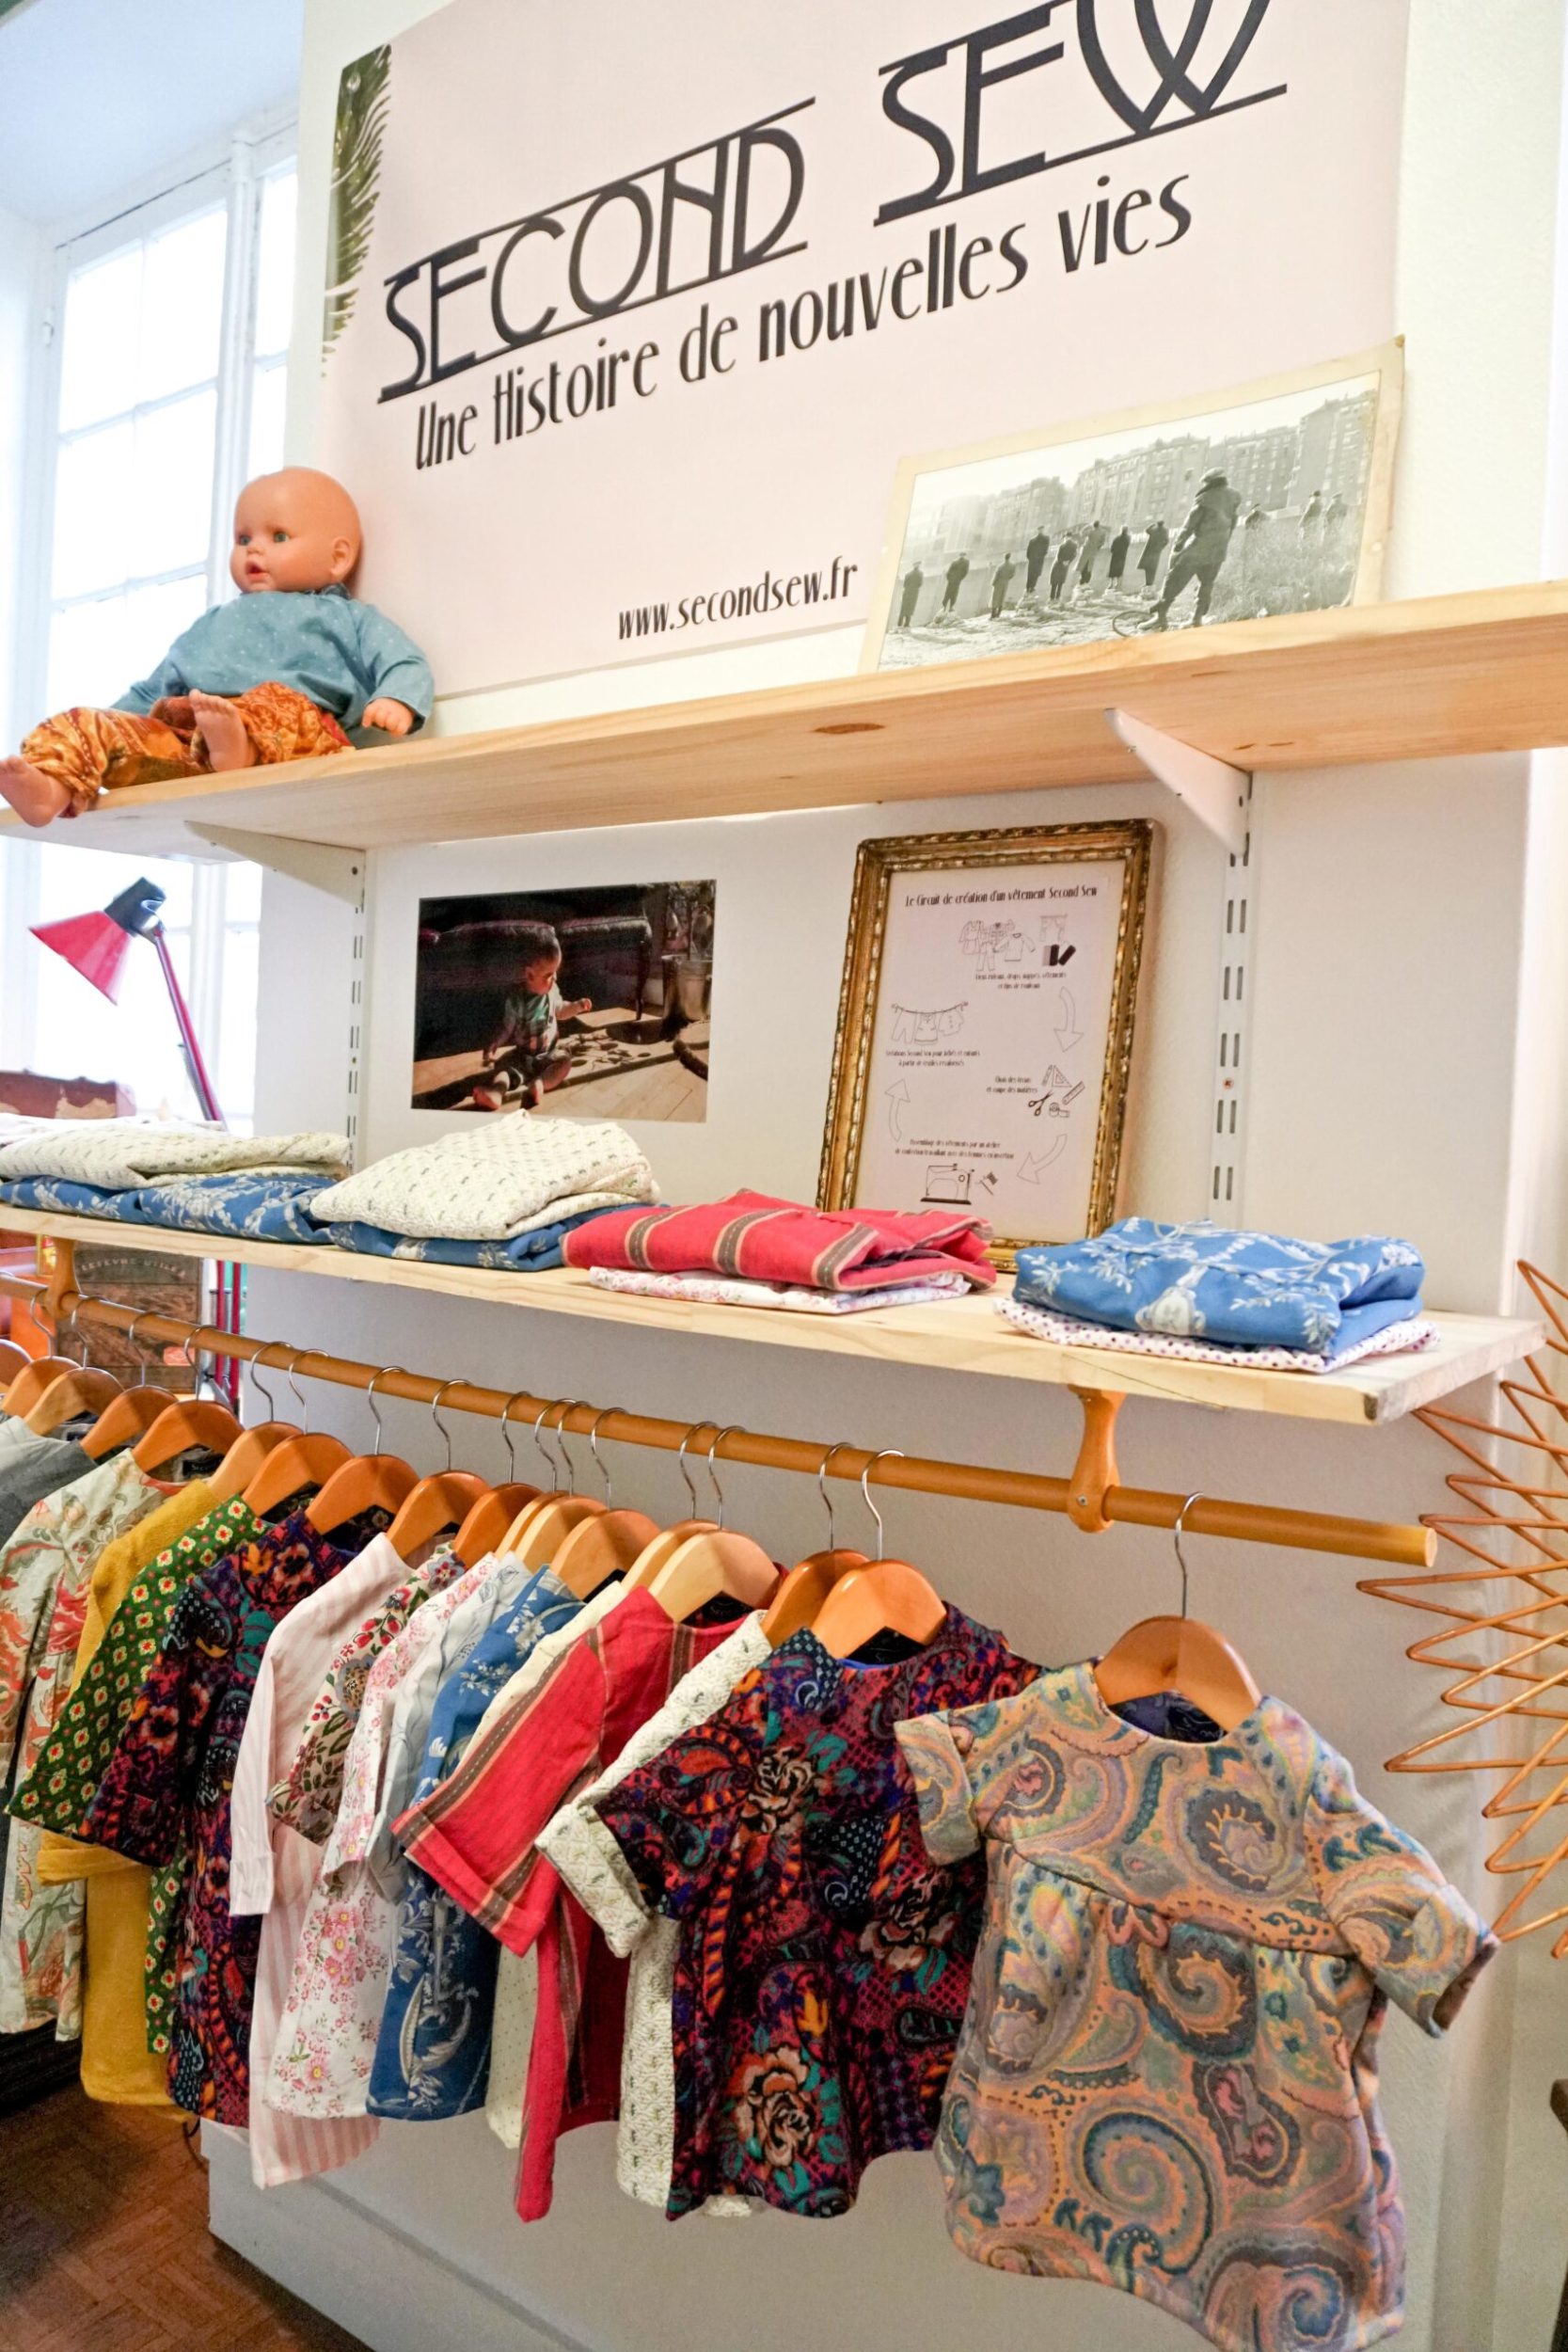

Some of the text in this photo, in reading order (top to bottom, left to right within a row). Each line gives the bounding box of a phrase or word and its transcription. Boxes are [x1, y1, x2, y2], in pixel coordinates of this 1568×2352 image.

[378, 0, 1287, 404] SECOND SEW
[415, 174, 1192, 470] Une Histoire de nouvelles vies
[619, 555, 858, 640] www.secondsew.fr
[942, 893, 953, 904] de
[1008, 887, 1045, 900] vêtement
[1049, 885, 1079, 898] Second
[1082, 884, 1098, 897] Sew
